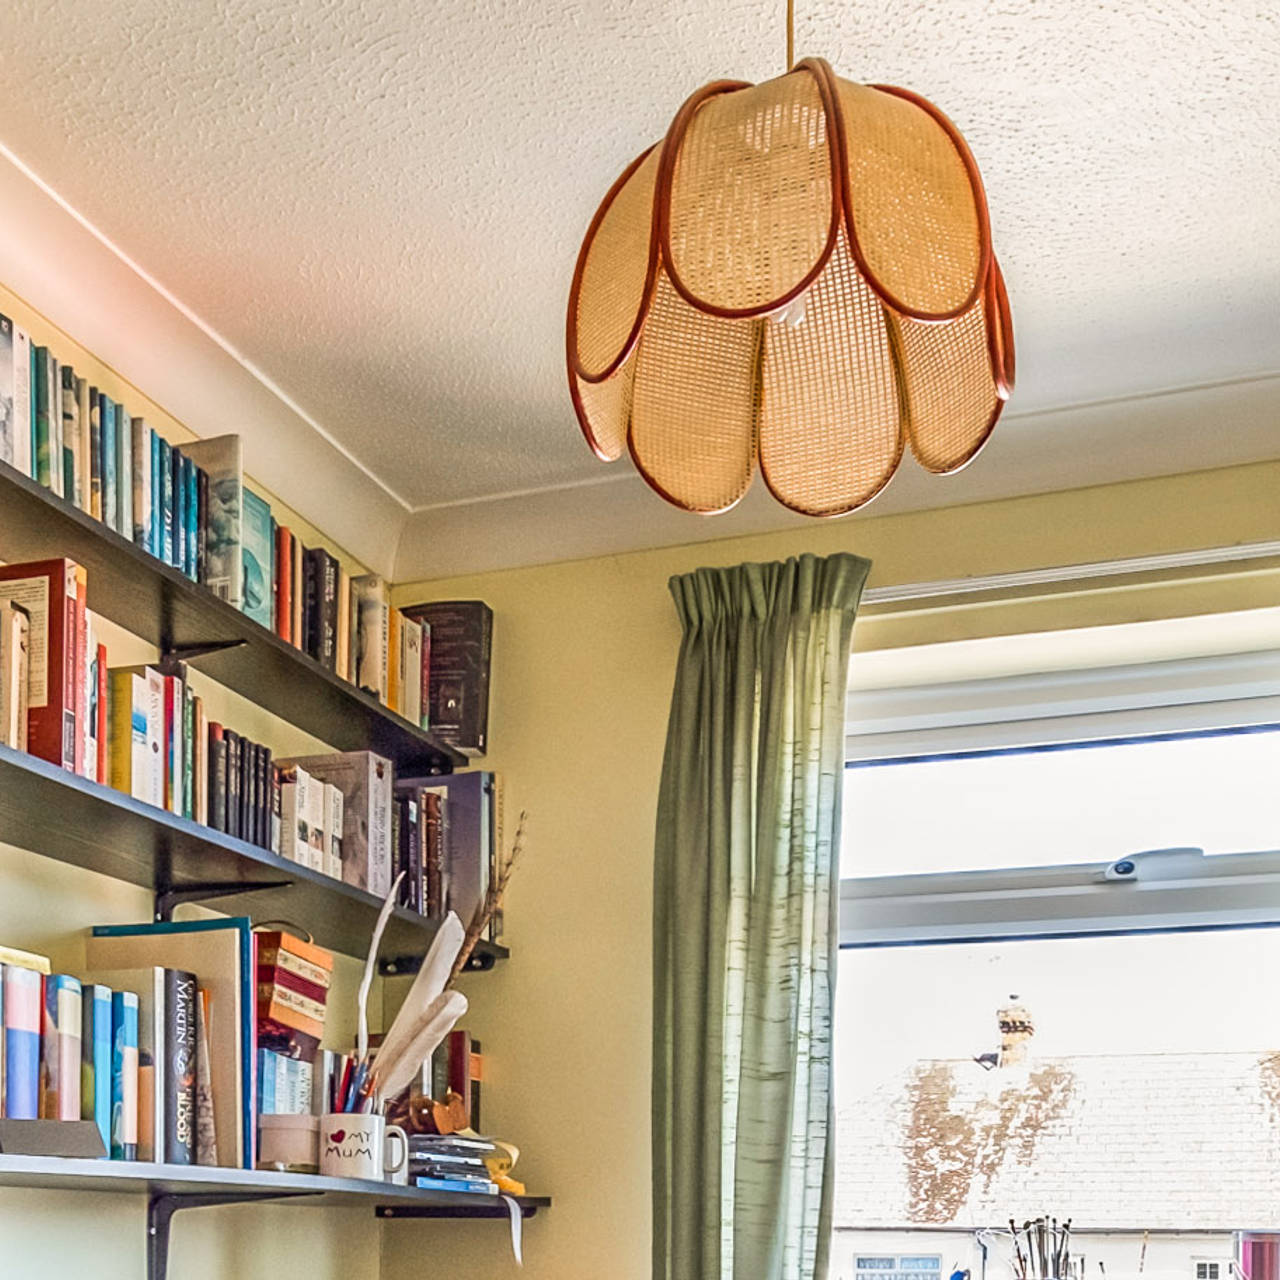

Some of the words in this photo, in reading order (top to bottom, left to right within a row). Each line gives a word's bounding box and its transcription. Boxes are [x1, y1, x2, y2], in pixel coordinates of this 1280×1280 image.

[176, 979, 188, 1044] MARTIN
[176, 1091, 187, 1143] BLOOD
[325, 1146, 372, 1160] MUM
[347, 1131, 372, 1144] MY
